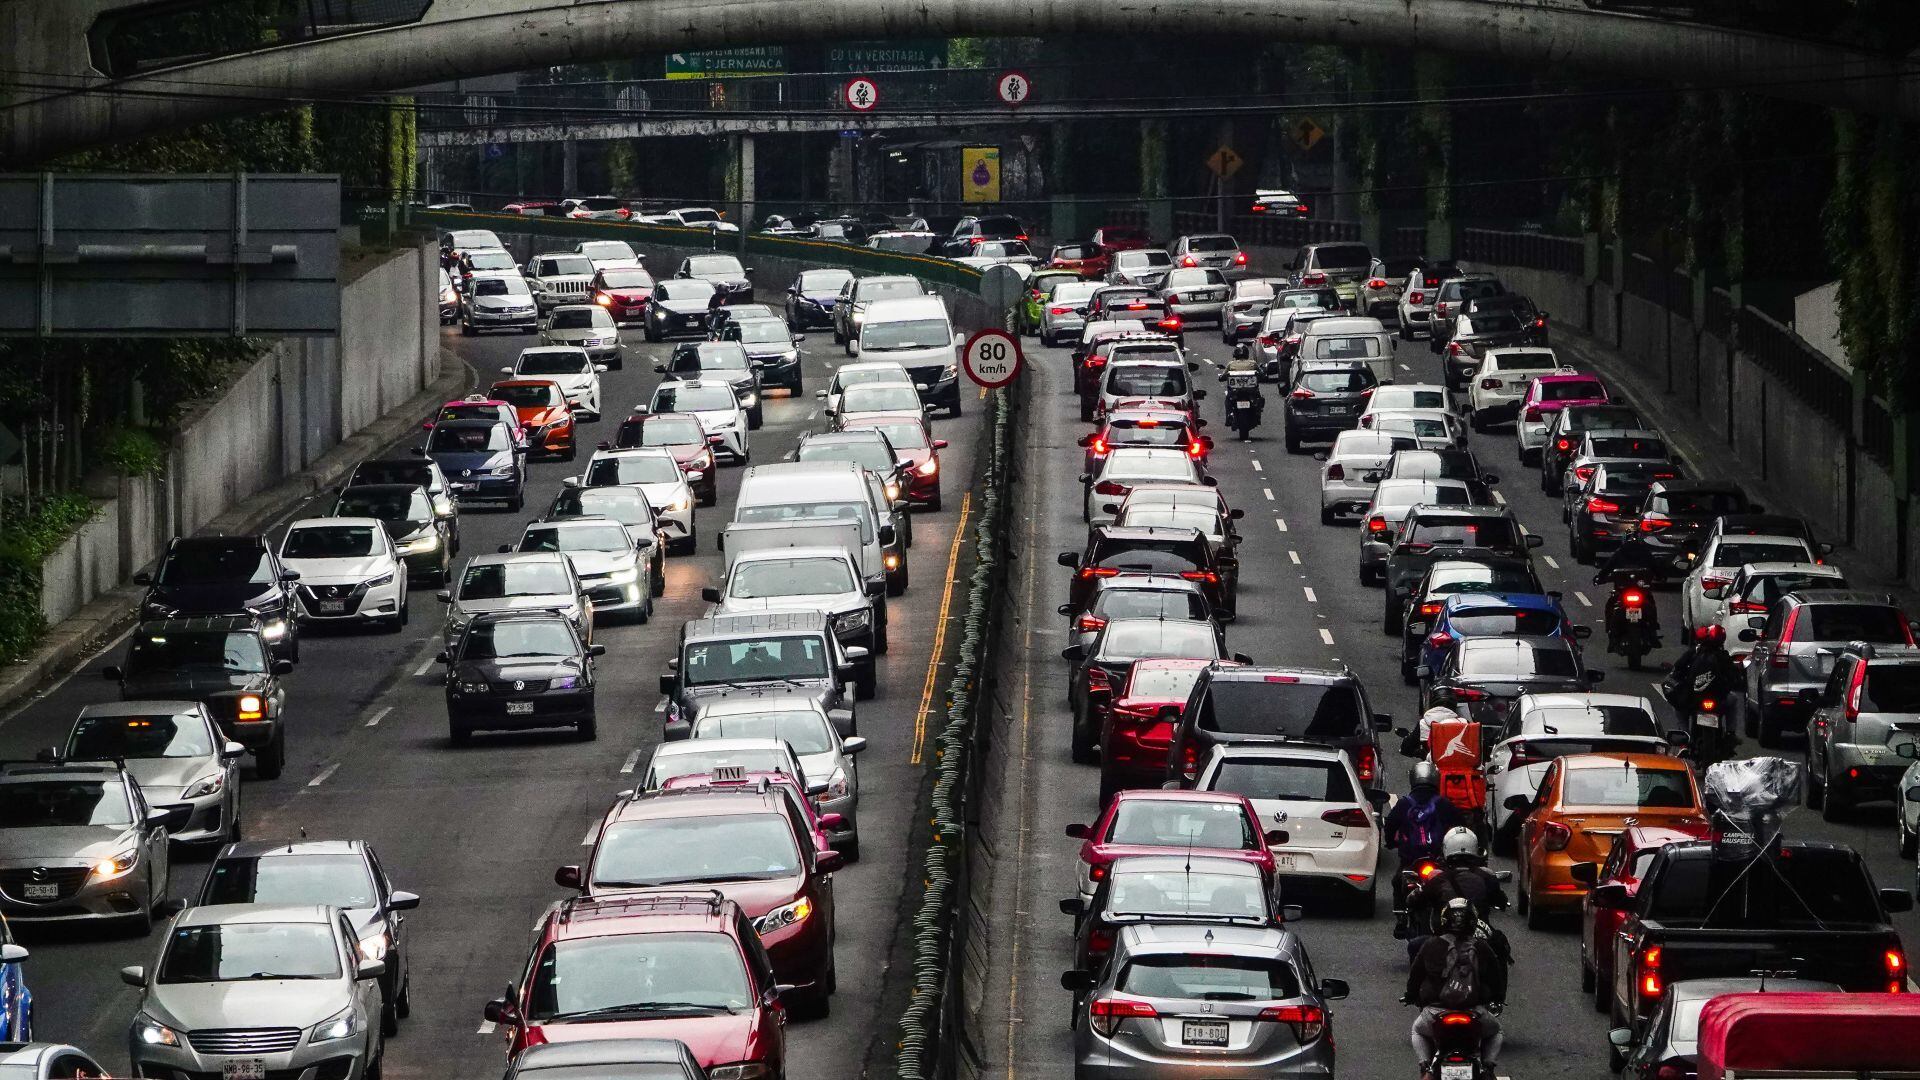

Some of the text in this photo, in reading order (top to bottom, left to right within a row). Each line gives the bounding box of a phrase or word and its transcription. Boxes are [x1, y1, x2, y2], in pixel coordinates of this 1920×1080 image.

[847, 50, 926, 61] UNVERSITARIA
[980, 343, 1006, 361] 80
[979, 363, 1007, 374] km/h
[716, 767, 741, 780] TAXI
